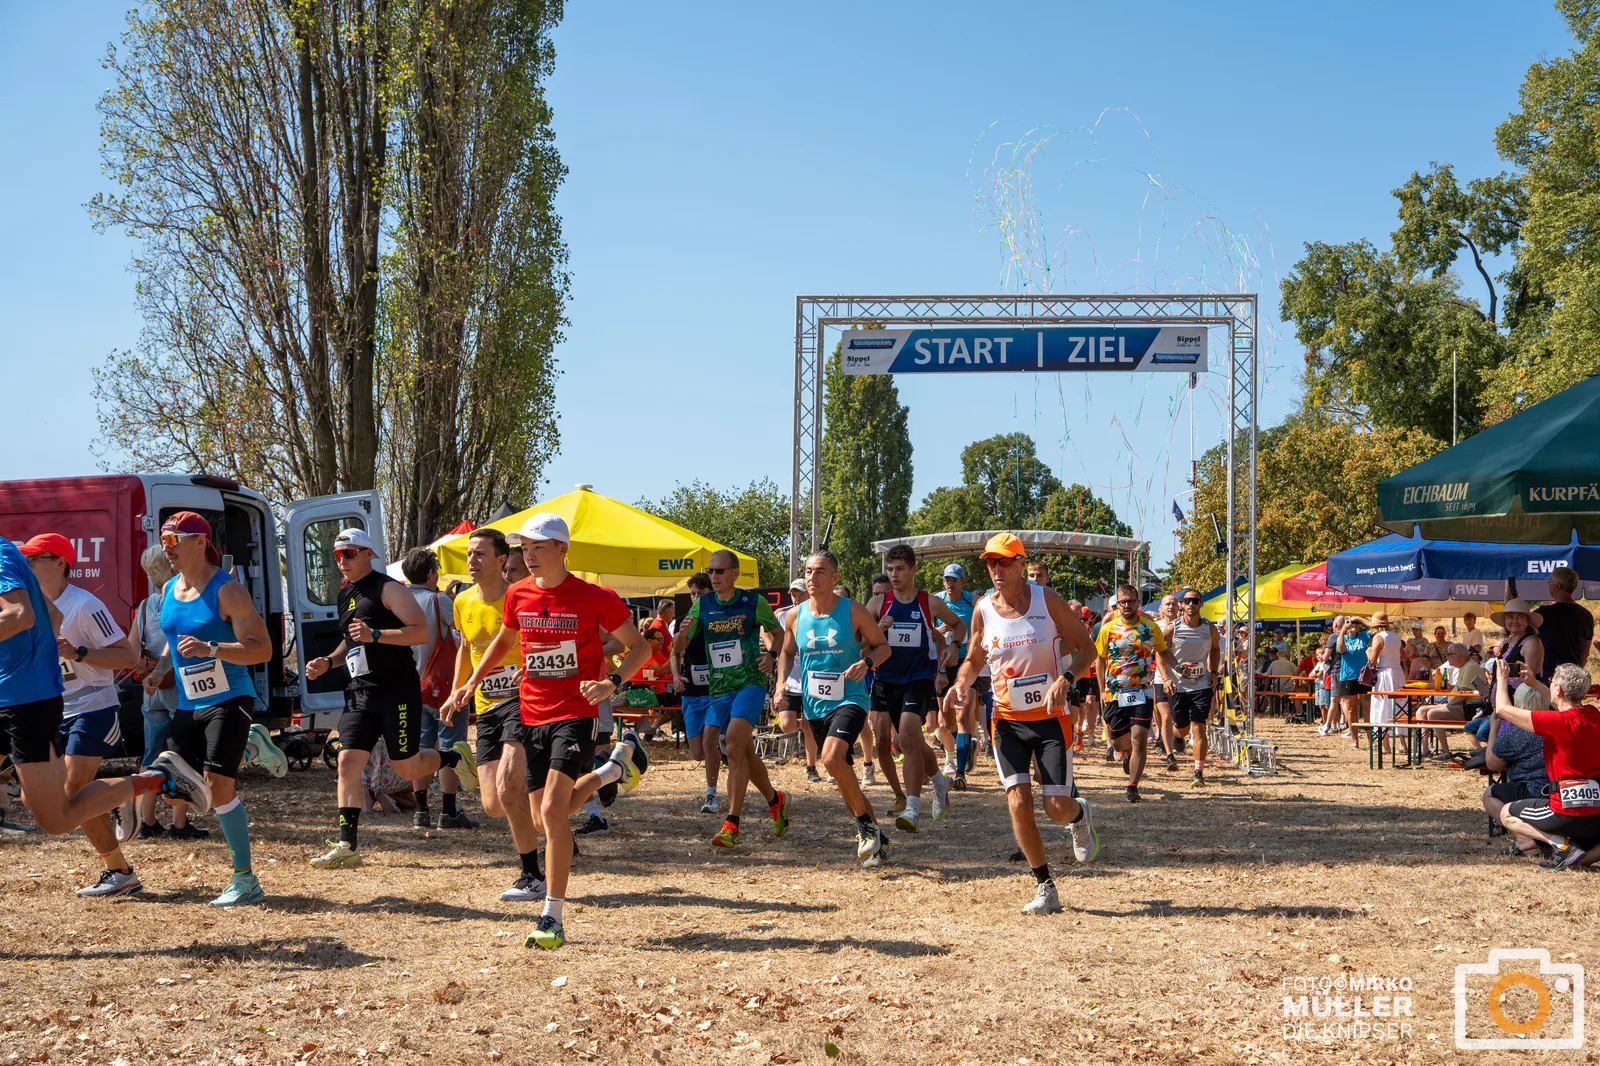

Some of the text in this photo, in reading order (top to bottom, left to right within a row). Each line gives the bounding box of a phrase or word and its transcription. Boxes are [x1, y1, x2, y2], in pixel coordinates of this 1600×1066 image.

[1176, 335, 1201, 343] Sippel
[914, 337, 1014, 365] START
[1068, 336, 1134, 363] ZIEL
[846, 355, 871, 363] Sippel
[1403, 481, 1470, 505] EICHBAUM
[1444, 501, 1460, 512] SEIT
[658, 558, 695, 571] EWR
[85, 568, 100, 577] BW
[1356, 567, 1377, 576] Bewegt,
[1388, 565, 1400, 573] Euch
[898, 633, 911, 643] 78
[1003, 638, 1037, 649] sports
[527, 653, 576, 670] 23434
[719, 653, 732, 663] 76
[191, 676, 216, 693] 103
[818, 685, 832, 696] 52
[1024, 690, 1042, 705] 86
[398, 703, 408, 753] ACHORE
[1562, 788, 1600, 800] 23405
